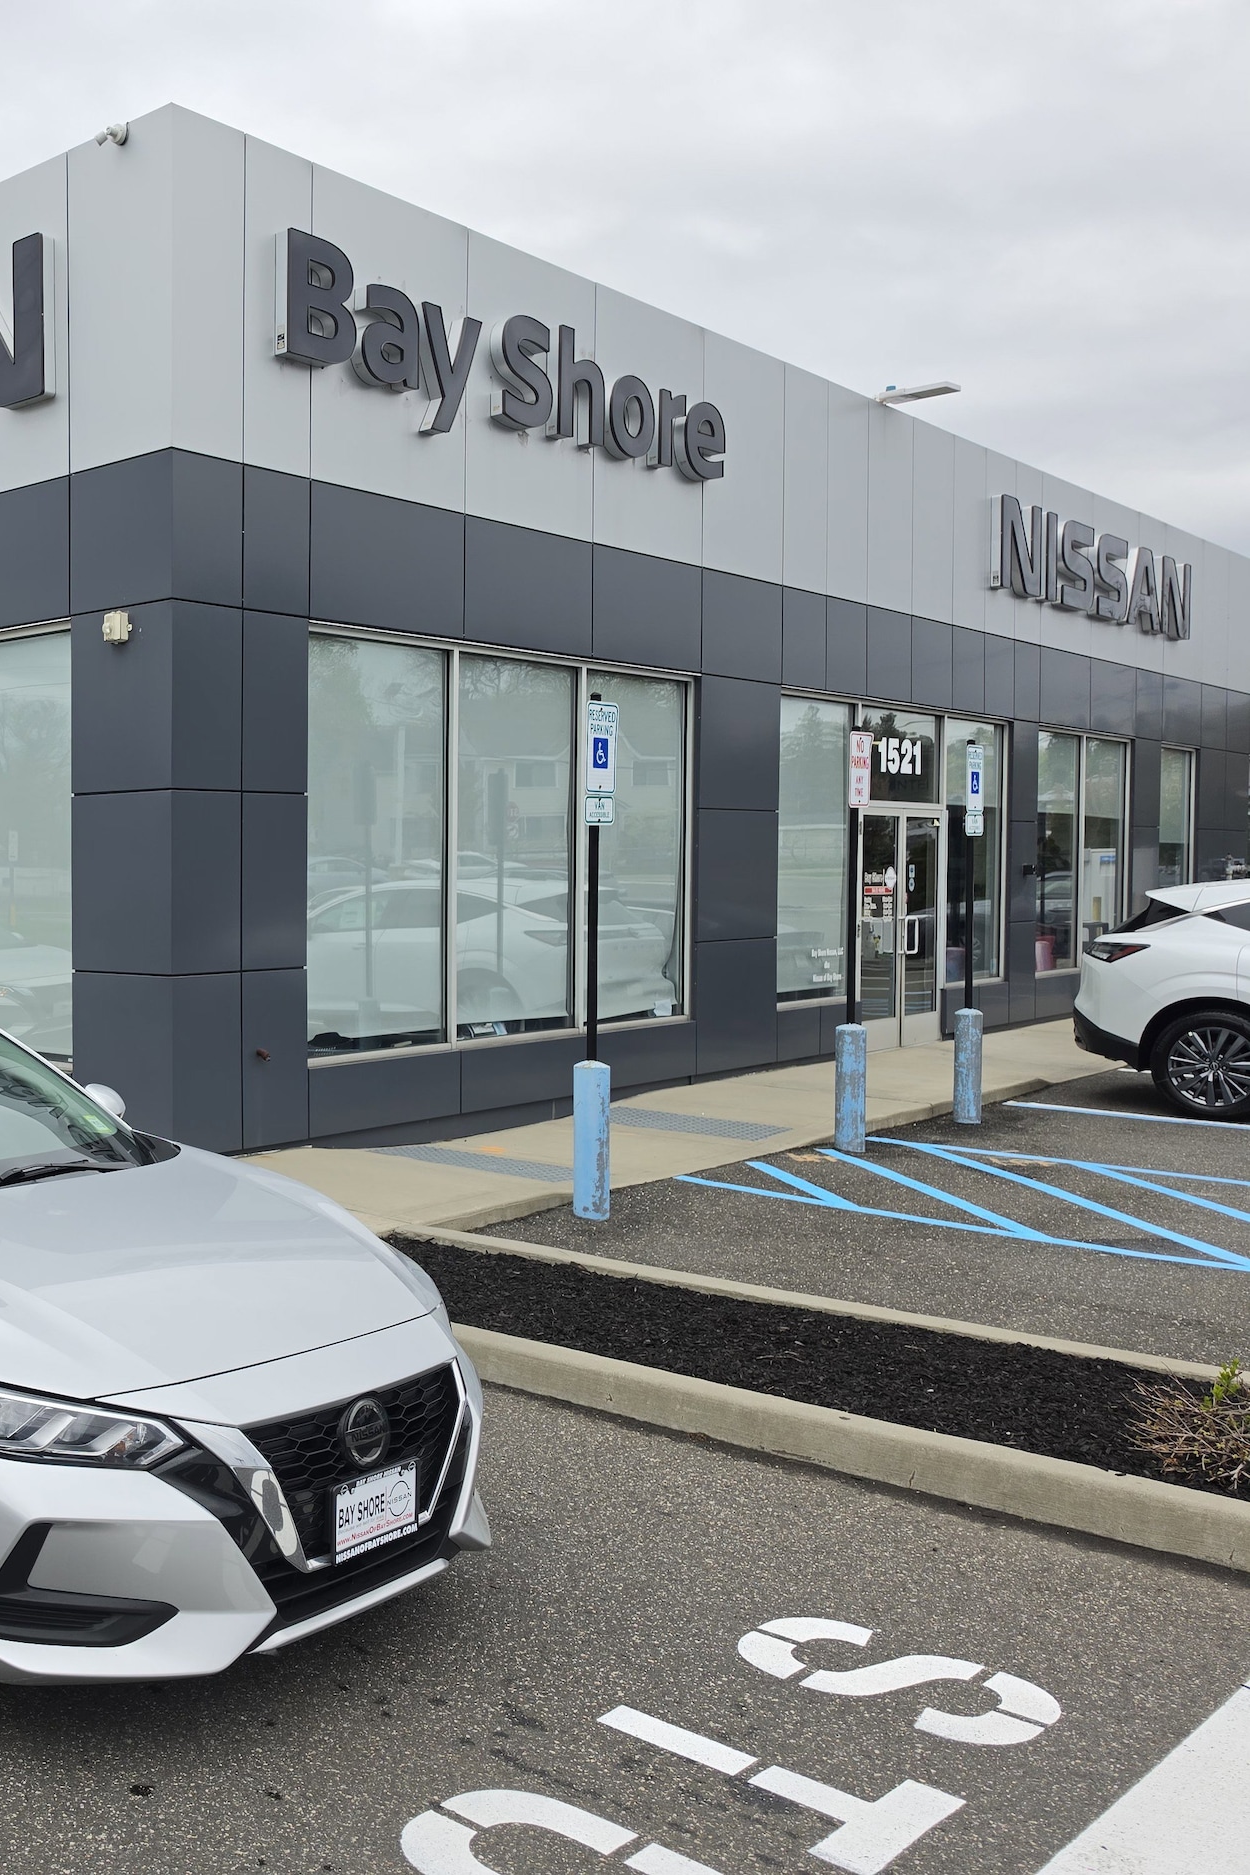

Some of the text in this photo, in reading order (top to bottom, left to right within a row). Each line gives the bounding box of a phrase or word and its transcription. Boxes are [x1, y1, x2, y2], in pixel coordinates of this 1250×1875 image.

[274, 227, 726, 482] Bay Shore
[990, 493, 1192, 641] NISSAN
[590, 709, 616, 723] RESERVED
[590, 724, 613, 736] PARKING
[856, 740, 865, 753] NO
[878, 736, 922, 775] 1521
[850, 756, 870, 770] PARKING
[855, 776, 864, 785] ANY
[854, 787, 864, 798] TIME
[594, 801, 606, 811] VAN
[352, 1423, 384, 1442] NISSAN
[387, 1491, 413, 1506] NISSAN
[338, 1492, 385, 1529] BAY SHORE
[335, 1521, 419, 1565] NISSANOFBAYSHORE.COM
